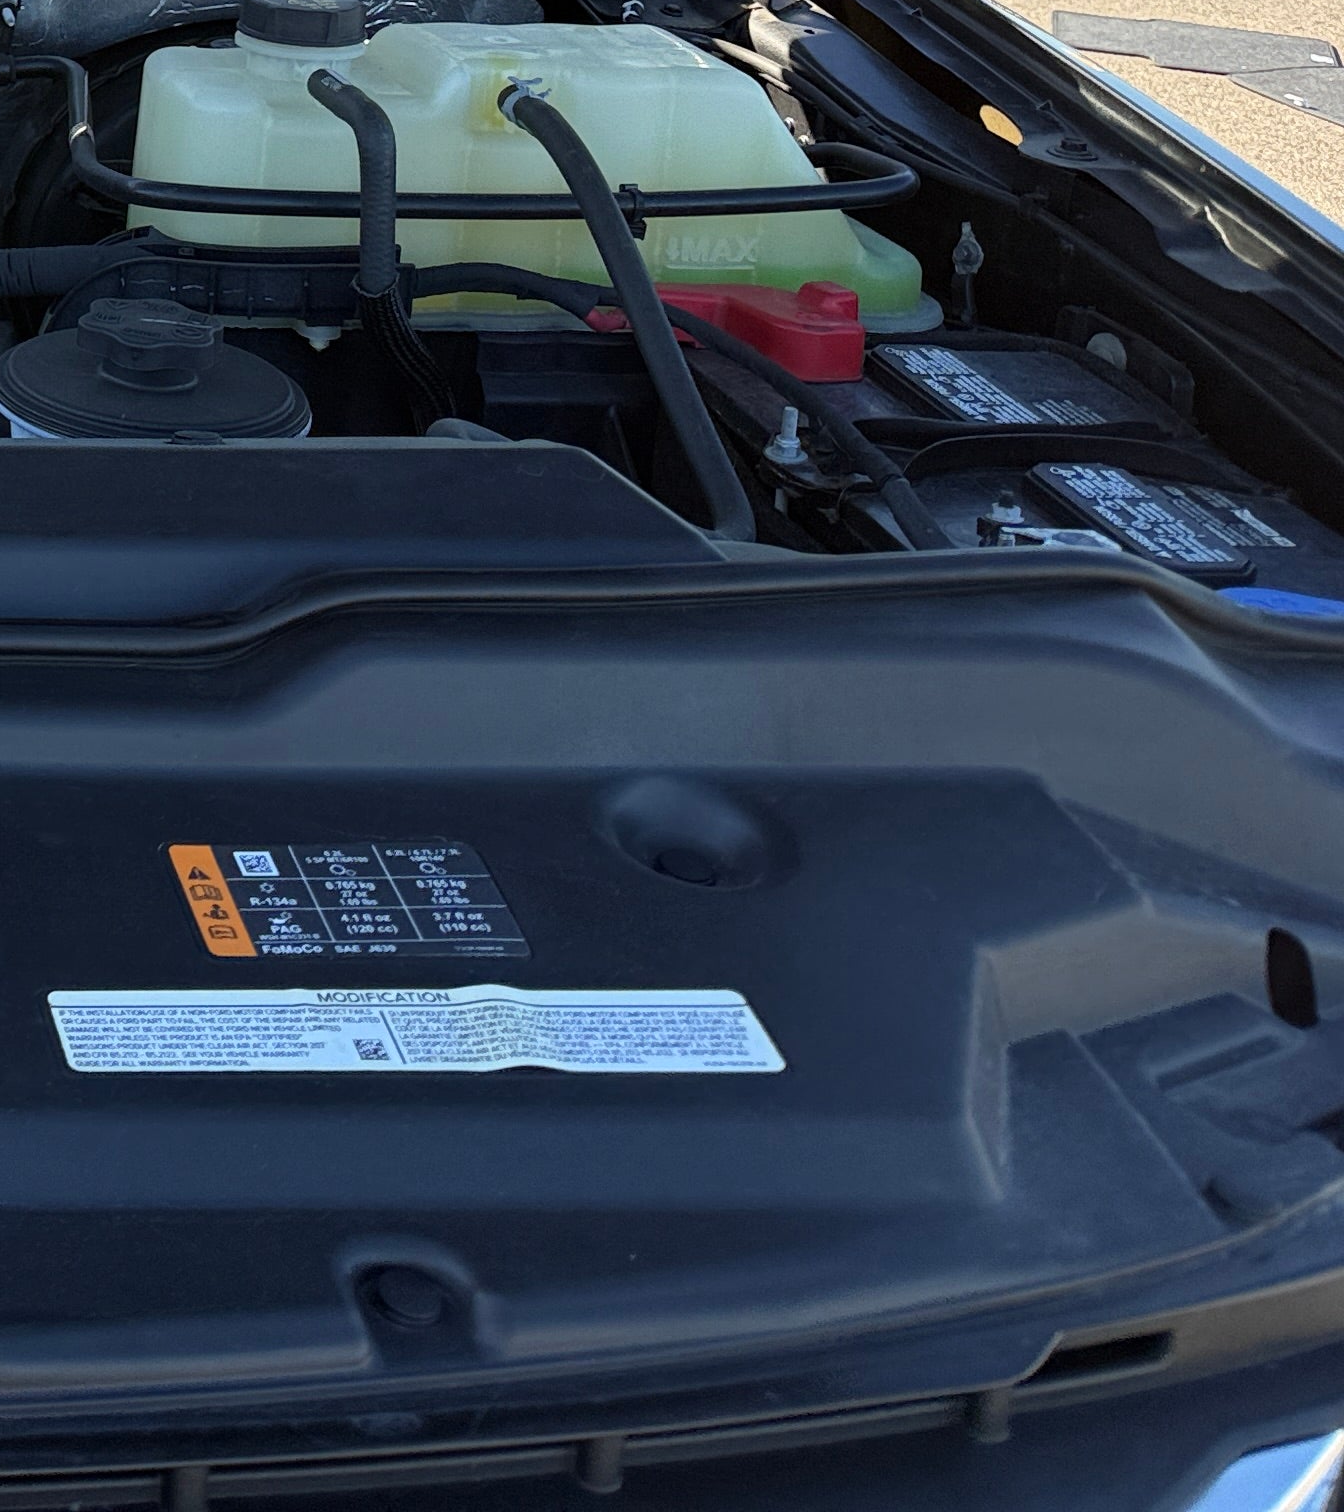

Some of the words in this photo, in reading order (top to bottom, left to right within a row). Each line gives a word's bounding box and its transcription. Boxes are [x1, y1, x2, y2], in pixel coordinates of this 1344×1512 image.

[681, 237, 757, 262] MAX
[359, 881, 376, 891] kg
[450, 880, 467, 890] kg
[249, 897, 297, 906] R-134a
[340, 914, 359, 922] 4.1
[432, 912, 451, 921] 3.7
[467, 913, 484, 921] oz
[270, 924, 302, 934] PAG
[346, 924, 375, 935] (120
[377, 924, 399, 935] cc)
[439, 923, 468, 934] (110
[470, 923, 492, 933] cc)
[261, 944, 324, 954] FoMoCo
[334, 945, 361, 953] SAE
[316, 991, 450, 1003] MODIFICATION
